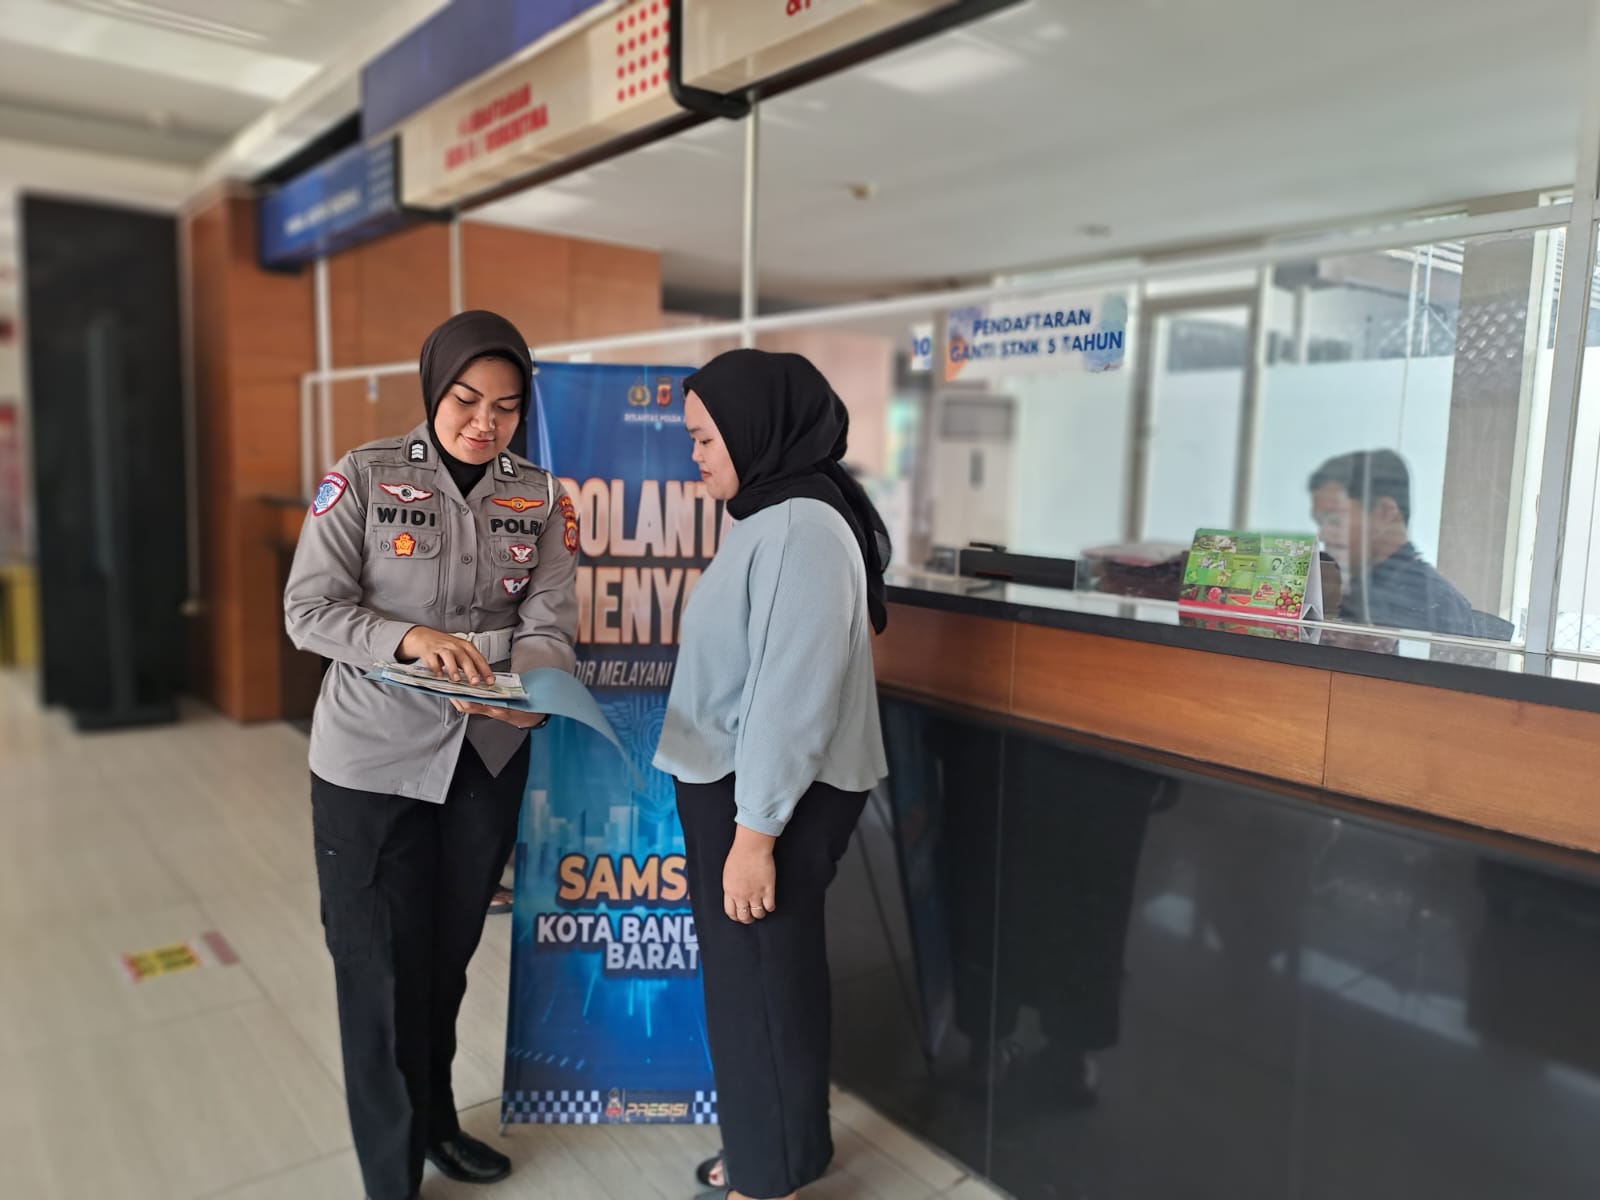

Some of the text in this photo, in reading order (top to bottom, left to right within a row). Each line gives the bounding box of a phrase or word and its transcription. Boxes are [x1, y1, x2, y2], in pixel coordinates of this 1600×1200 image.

[972, 309, 1092, 337] PENDAFTARAN
[1048, 336, 1056, 354] 5
[1062, 331, 1123, 352] TAHUN
[376, 507, 436, 528] WIDI
[490, 518, 543, 537] POLRI
[597, 660, 672, 687] MELAYANI
[558, 855, 690, 902] SAMS
[537, 915, 614, 943] KOTA
[606, 942, 700, 970] BARAT
[624, 1103, 689, 1119] PRESISI
